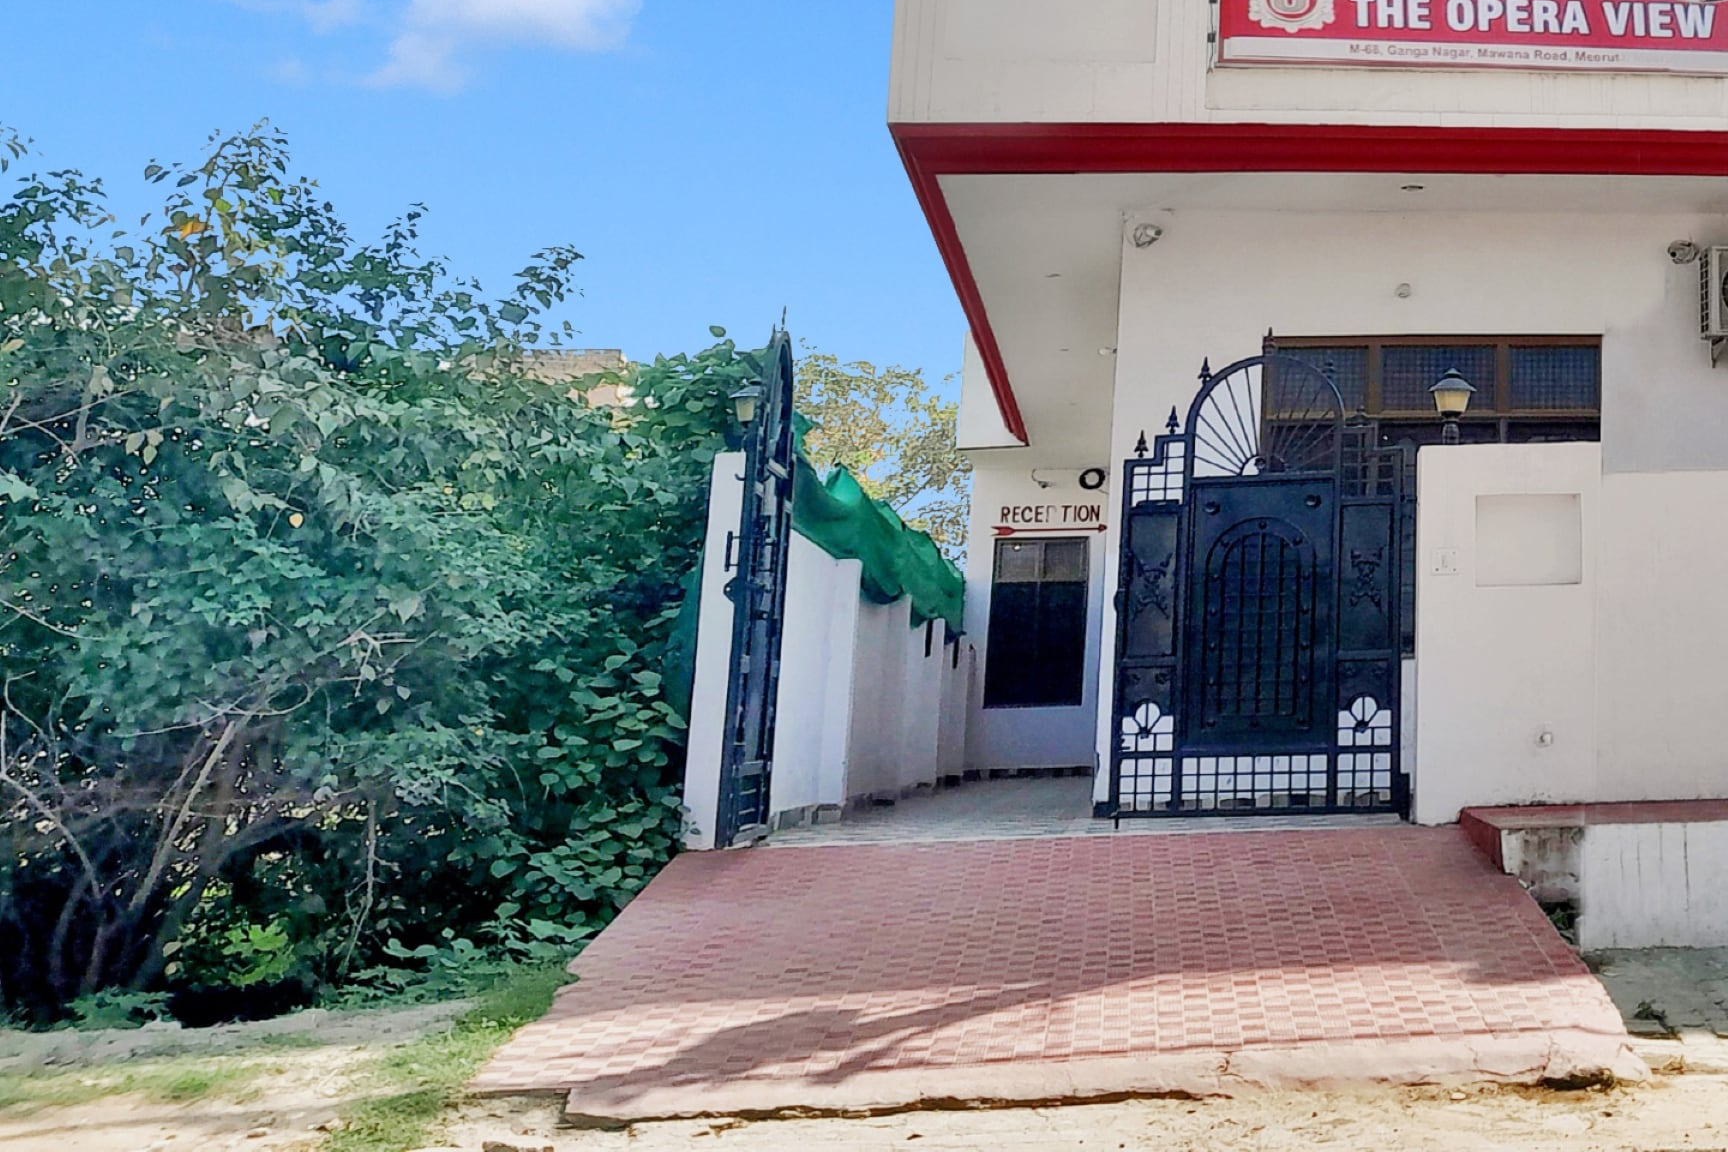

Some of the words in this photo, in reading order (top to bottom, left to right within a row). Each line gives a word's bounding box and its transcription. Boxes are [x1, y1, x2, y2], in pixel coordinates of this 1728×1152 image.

[1602, 0, 1717, 39] VIEW
[1387, 45, 1428, 57] Ganga
[1432, 47, 1473, 59] Nagar,
[1477, 48, 1530, 59] Mawana
[1534, 50, 1571, 62] Road,
[1575, 51, 1620, 62] Meerut
